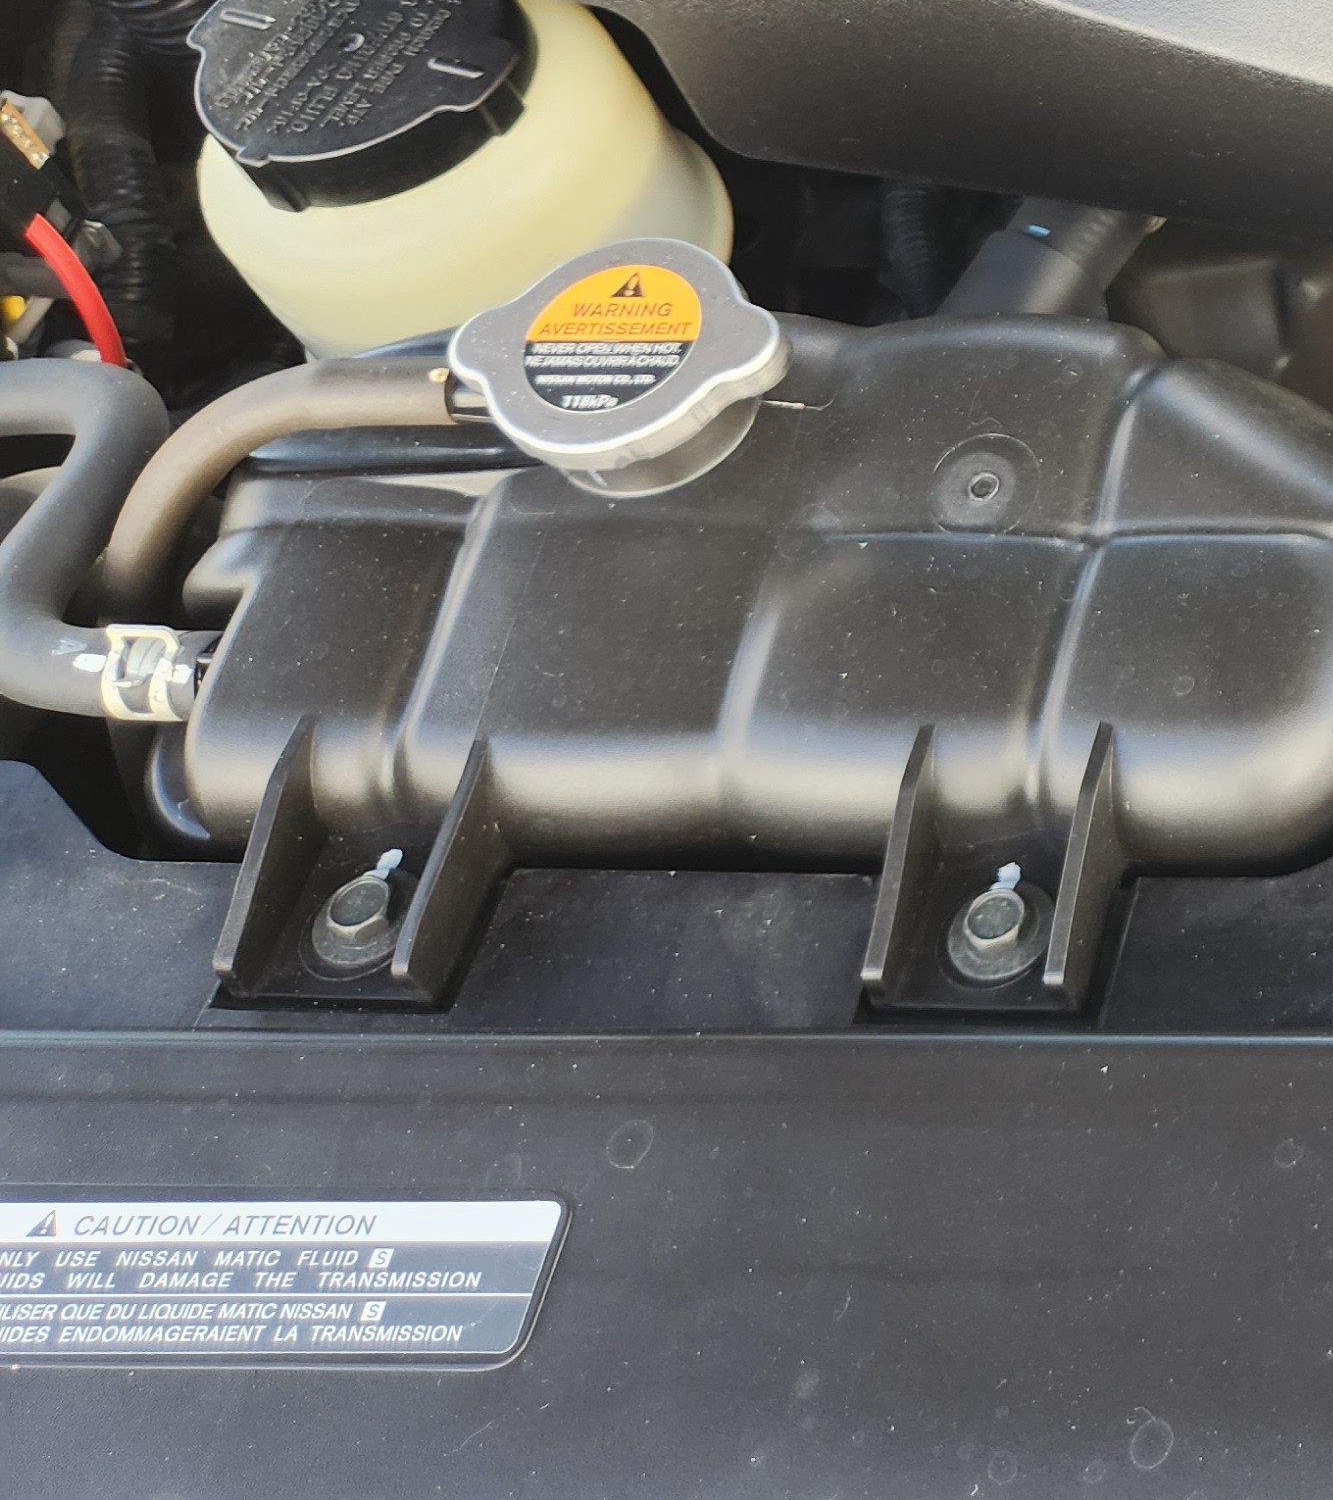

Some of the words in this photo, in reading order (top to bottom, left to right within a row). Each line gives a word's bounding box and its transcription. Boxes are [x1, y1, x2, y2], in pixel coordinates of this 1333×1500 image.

[574, 303, 673, 317] WARNING
[539, 322, 693, 335] AVERTISSEMENT
[533, 342, 577, 355] NEVER
[609, 342, 652, 355] WHEN
[534, 374, 575, 386] NISSAN
[561, 394, 619, 409] 118kPa
[73, 1215, 202, 1237] CAUTION
[222, 1214, 378, 1237] ATTENTION
[0, 1250, 40, 1268] NLY
[55, 1250, 102, 1268] USE
[115, 1250, 200, 1268] NISSAN
[213, 1250, 281, 1268] MATIC
[296, 1249, 360, 1267] FLUID
[66, 1272, 117, 1289] WILL
[138, 1271, 235, 1289] DAMAGE
[254, 1271, 298, 1288] THE
[317, 1271, 482, 1288] TRANSMISSION
[0, 1303, 58, 1320] ILISER
[60, 1303, 105, 1321] QUE
[105, 1303, 140, 1320] DU
[137, 1303, 218, 1320] LIQUIDE
[216, 1303, 278, 1320] MATIC
[279, 1302, 354, 1319] NISSAN
[58, 1325, 268, 1343] ENDOMMAGERAIENT
[273, 1324, 299, 1342] LA
[310, 1324, 464, 1342] TRANSMISSION
